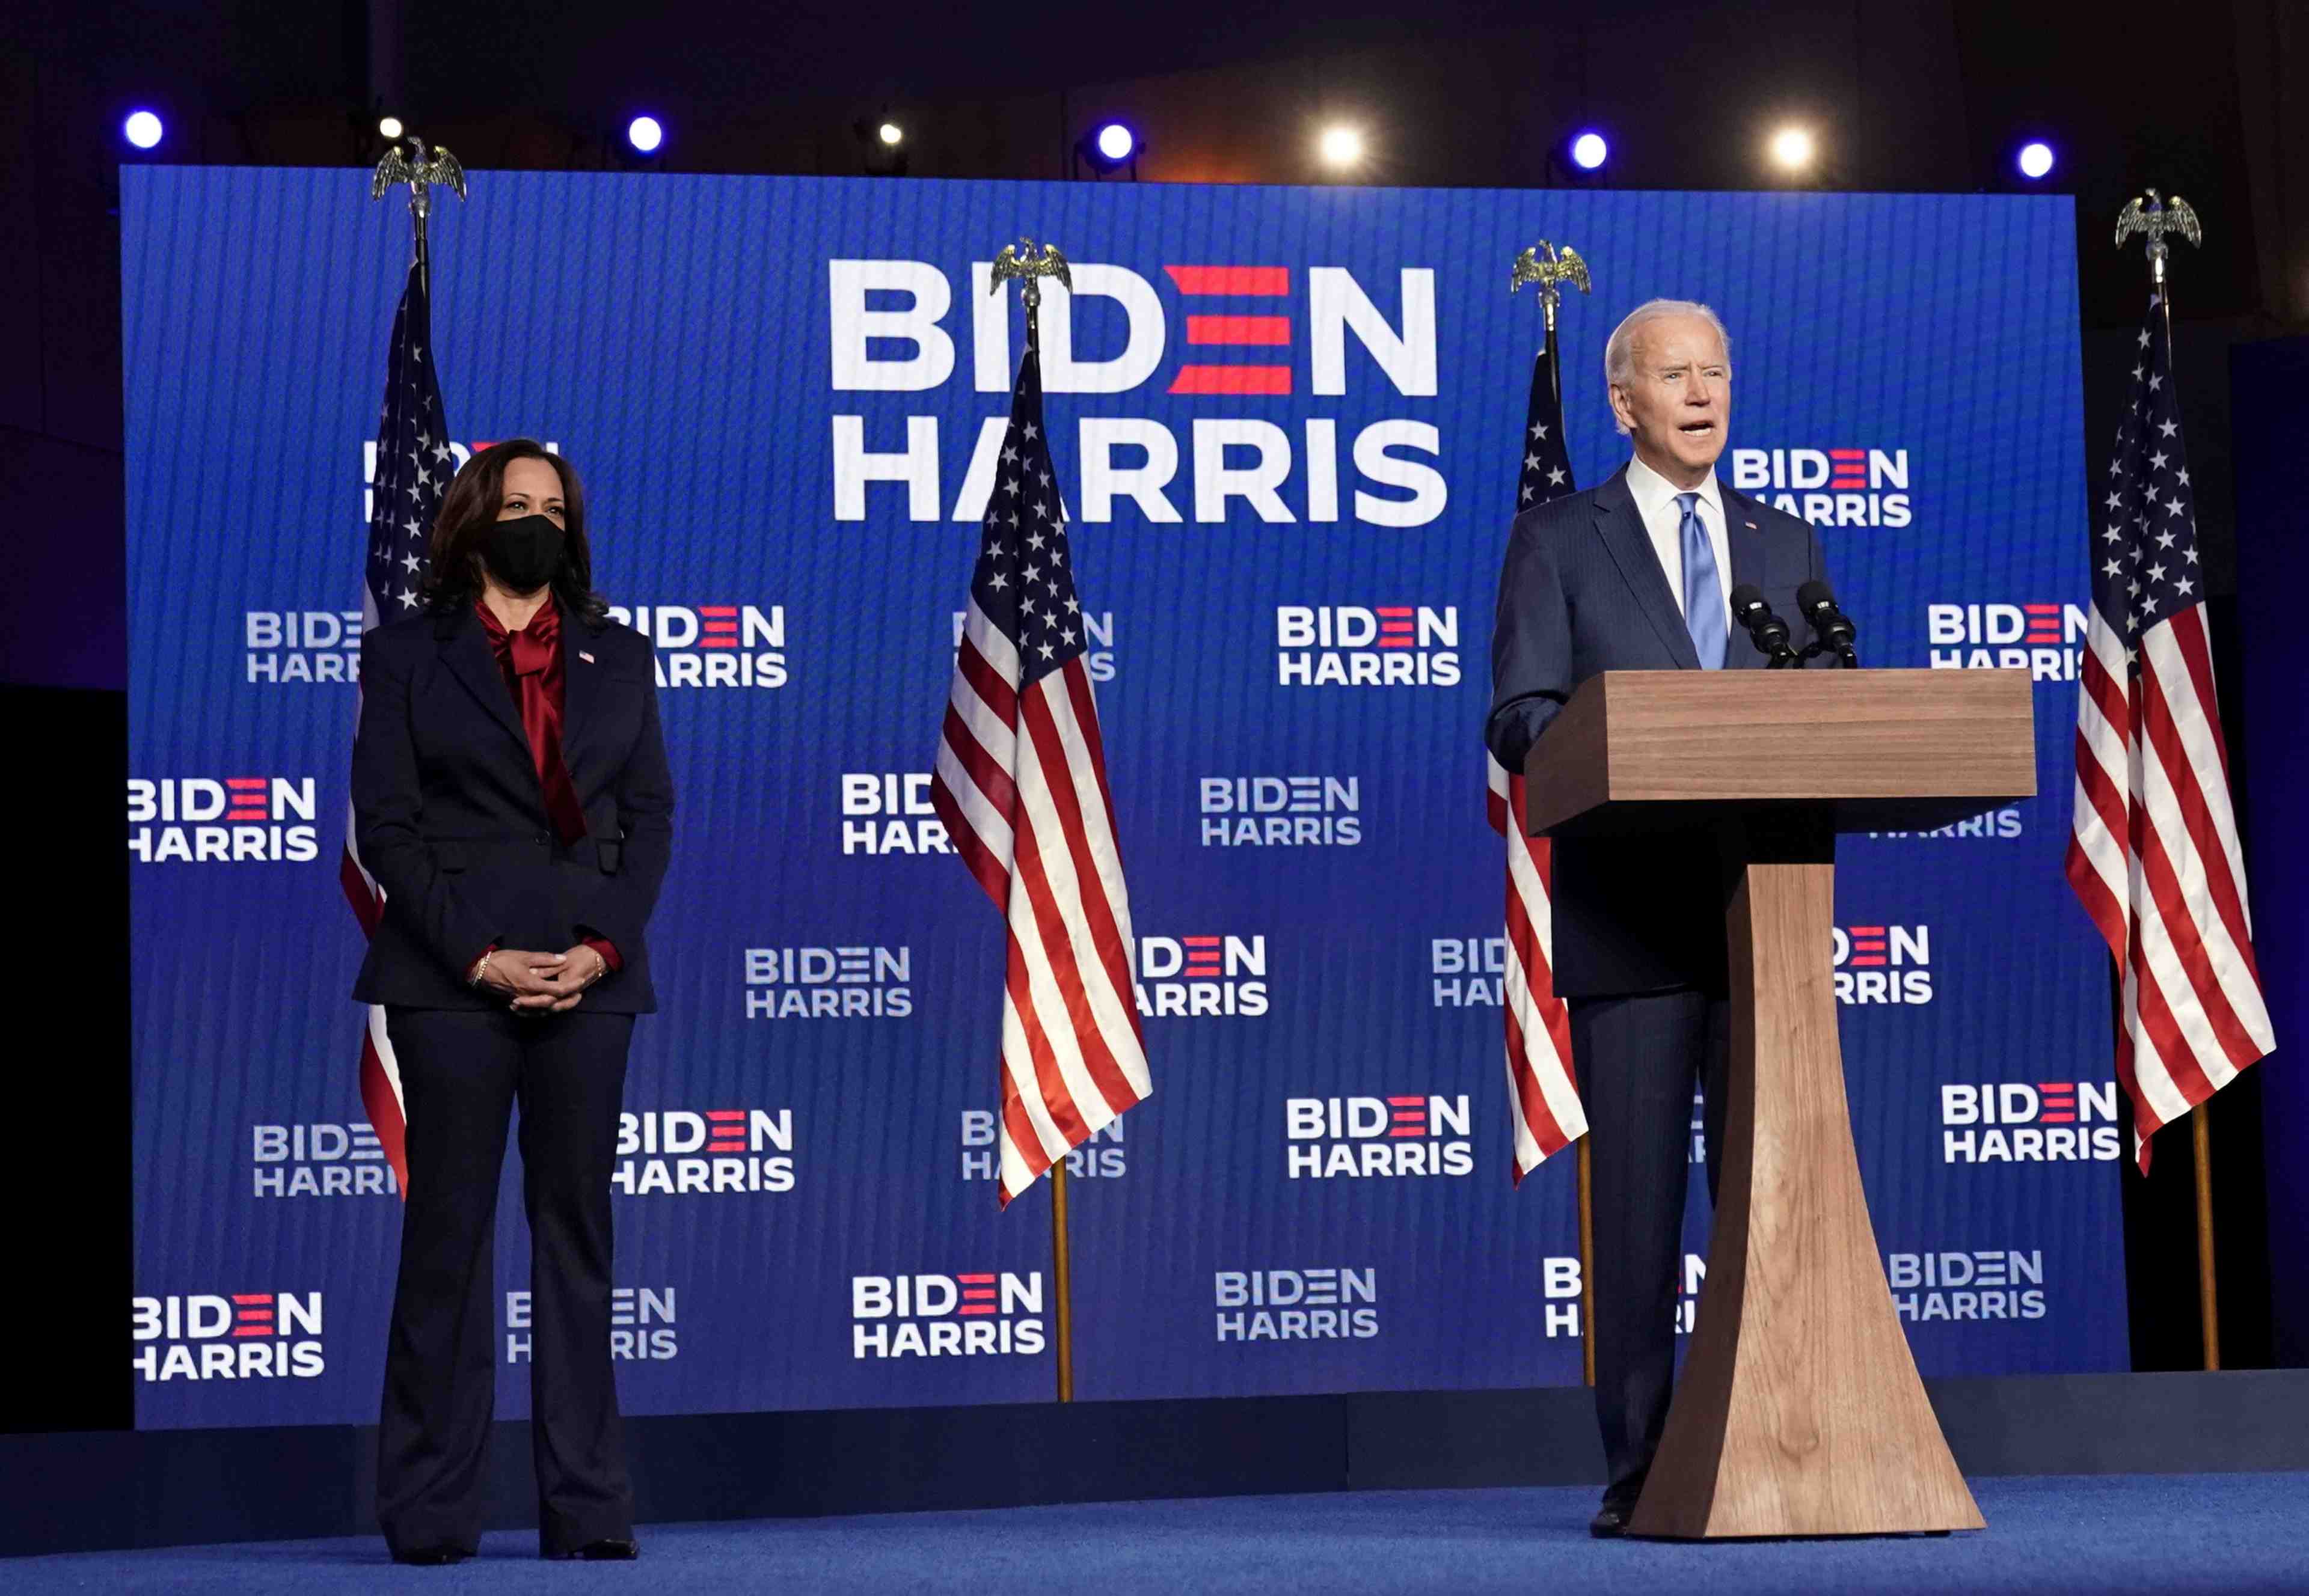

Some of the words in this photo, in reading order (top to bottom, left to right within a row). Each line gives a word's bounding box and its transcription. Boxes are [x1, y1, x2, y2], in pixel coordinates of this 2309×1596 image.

[829, 259, 1437, 396] BIDEN
[1732, 448, 1909, 489] BIDEN
[1755, 494, 1912, 527] ARRIS
[247, 612, 363, 648] BIDE
[1277, 605, 1458, 647] BIDEN
[1278, 652, 1461, 686] HARRIS
[1930, 648, 2084, 681] HARRI
[127, 778, 316, 822] BIDEN
[842, 773, 936, 815] BID
[1201, 777, 1359, 813] BIDEN
[842, 820, 959, 855] HAR
[1201, 816, 1361, 846] HARRIS
[745, 947, 910, 984] BIDEN
[1132, 935, 1266, 977] DEN
[746, 987, 912, 1018] HARRIS
[1834, 970, 1933, 1004] RRIS
[1287, 1095, 1470, 1139] BIDEN
[1942, 1081, 2117, 1124] BIDEN
[253, 1124, 384, 1162] BIDE
[616, 1110, 792, 1154] BIDEN
[1943, 1127, 2121, 1163] HARRIS
[962, 1148, 1126, 1181] HRIS
[1288, 1141, 1473, 1178] HARRIS
[254, 1164, 397, 1197] HARRI
[1215, 1268, 1376, 1307] BIDEN
[1889, 1250, 2043, 1288] BIDEN
[852, 1271, 1043, 1318] BIDEN
[1892, 1290, 2046, 1321] HARRIS
[132, 1292, 322, 1340] BIDEN
[1216, 1309, 1379, 1342] HARRIS
[507, 1329, 678, 1363] HRIS
[853, 1319, 1046, 1359] HARRIS
